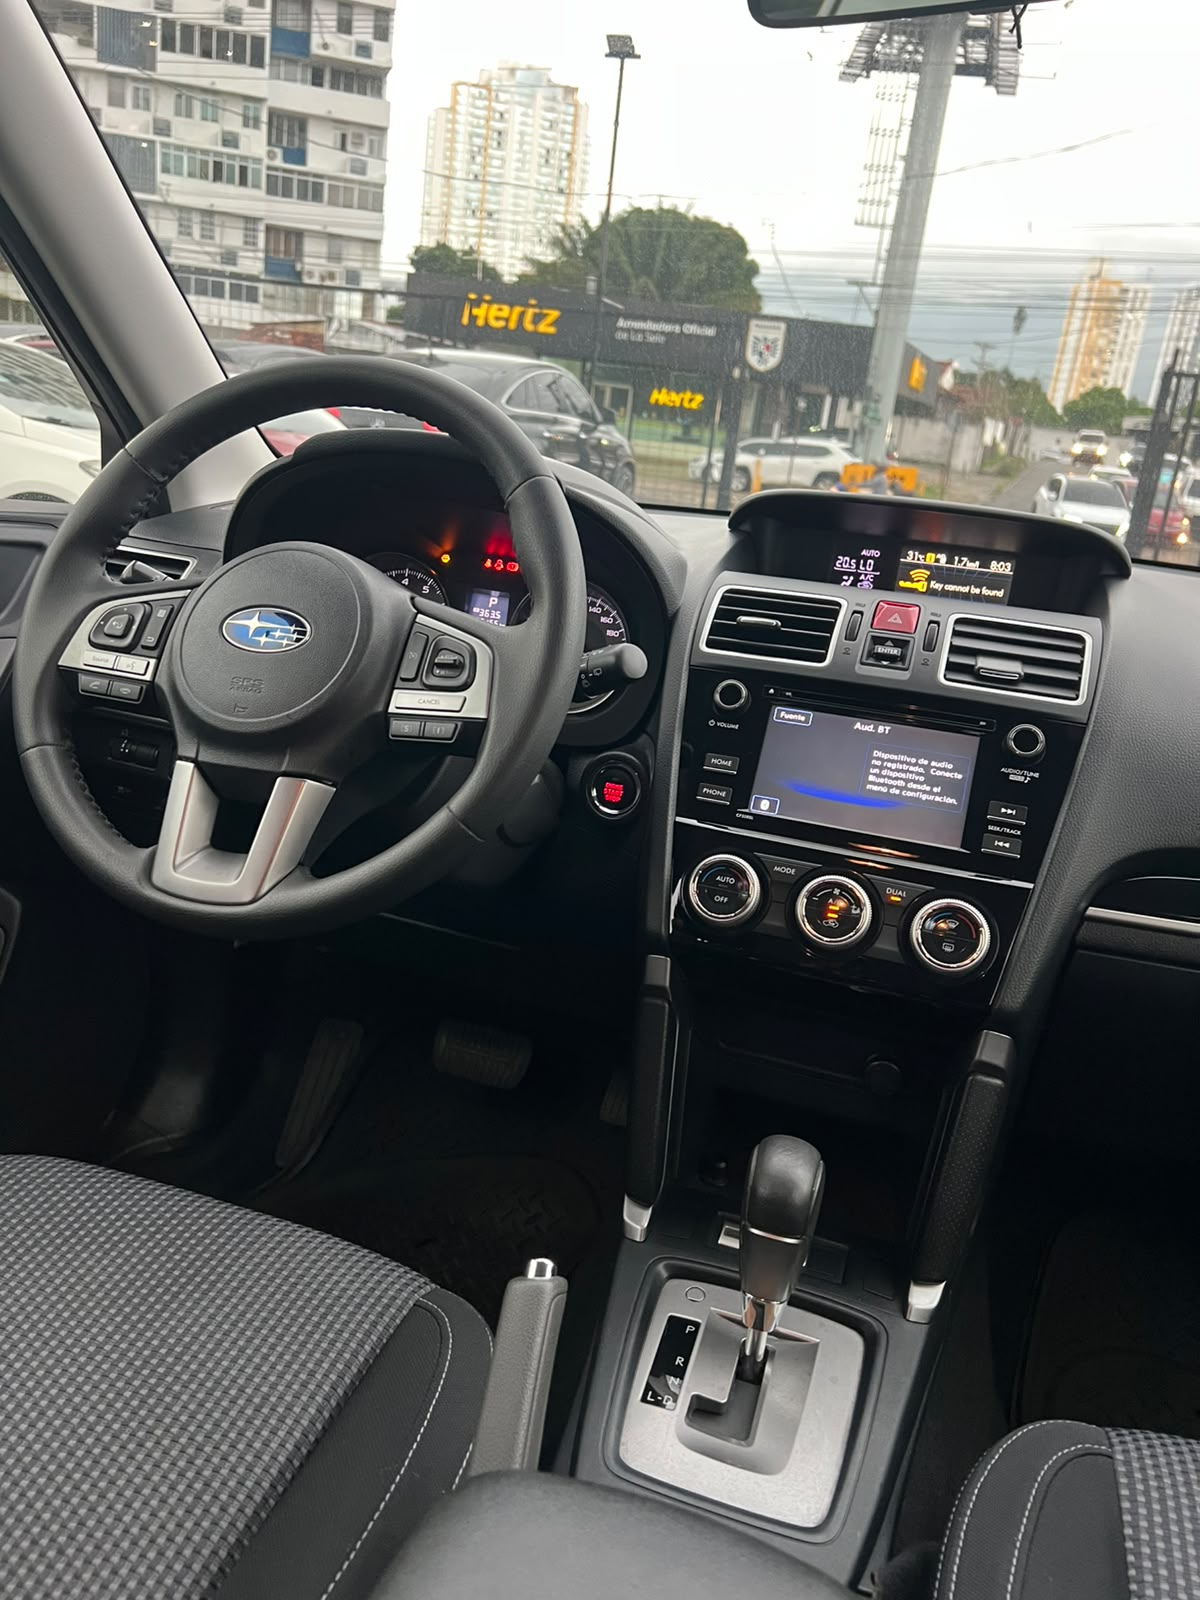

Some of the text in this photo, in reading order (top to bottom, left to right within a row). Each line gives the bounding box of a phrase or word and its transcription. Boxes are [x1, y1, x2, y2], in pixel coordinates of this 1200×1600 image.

[461, 293, 561, 335] Hertz
[650, 387, 704, 410] Hertz
[861, 549, 880, 557] AUTO
[990, 561, 1011, 572] 8:03
[401, 578, 409, 586] 4
[421, 585, 430, 593] 5
[930, 580, 1004, 598] Key cannot be found
[488, 596, 498, 608] P
[600, 616, 613, 624] 160
[877, 647, 899, 655] ENTER
[780, 711, 806, 722] Fuente
[716, 721, 739, 729] VOLUME
[854, 722, 891, 734] Aud. BT
[711, 757, 732, 766] HOME
[873, 750, 916, 763] Dispositivo
[930, 761, 953, 769] audio
[881, 769, 925, 782] dispositivo
[883, 761, 925, 774] registrado.
[930, 768, 963, 779] Conecte
[1000, 767, 1039, 778] AUDIO/TUNE
[868, 775, 905, 787] Bluetooth
[907, 782, 931, 791] desde
[702, 788, 727, 797] PHONE
[889, 787, 900, 795] de
[902, 789, 958, 805] configuración.
[988, 824, 1021, 835] SEEK/TRACK
[773, 865, 796, 875] MODE
[716, 875, 735, 884] AUTO
[886, 887, 906, 897] DUAL
[714, 895, 728, 903] OFF
[685, 1325, 695, 1334] P
[675, 1356, 684, 1367] R
[669, 1375, 680, 1385] N
